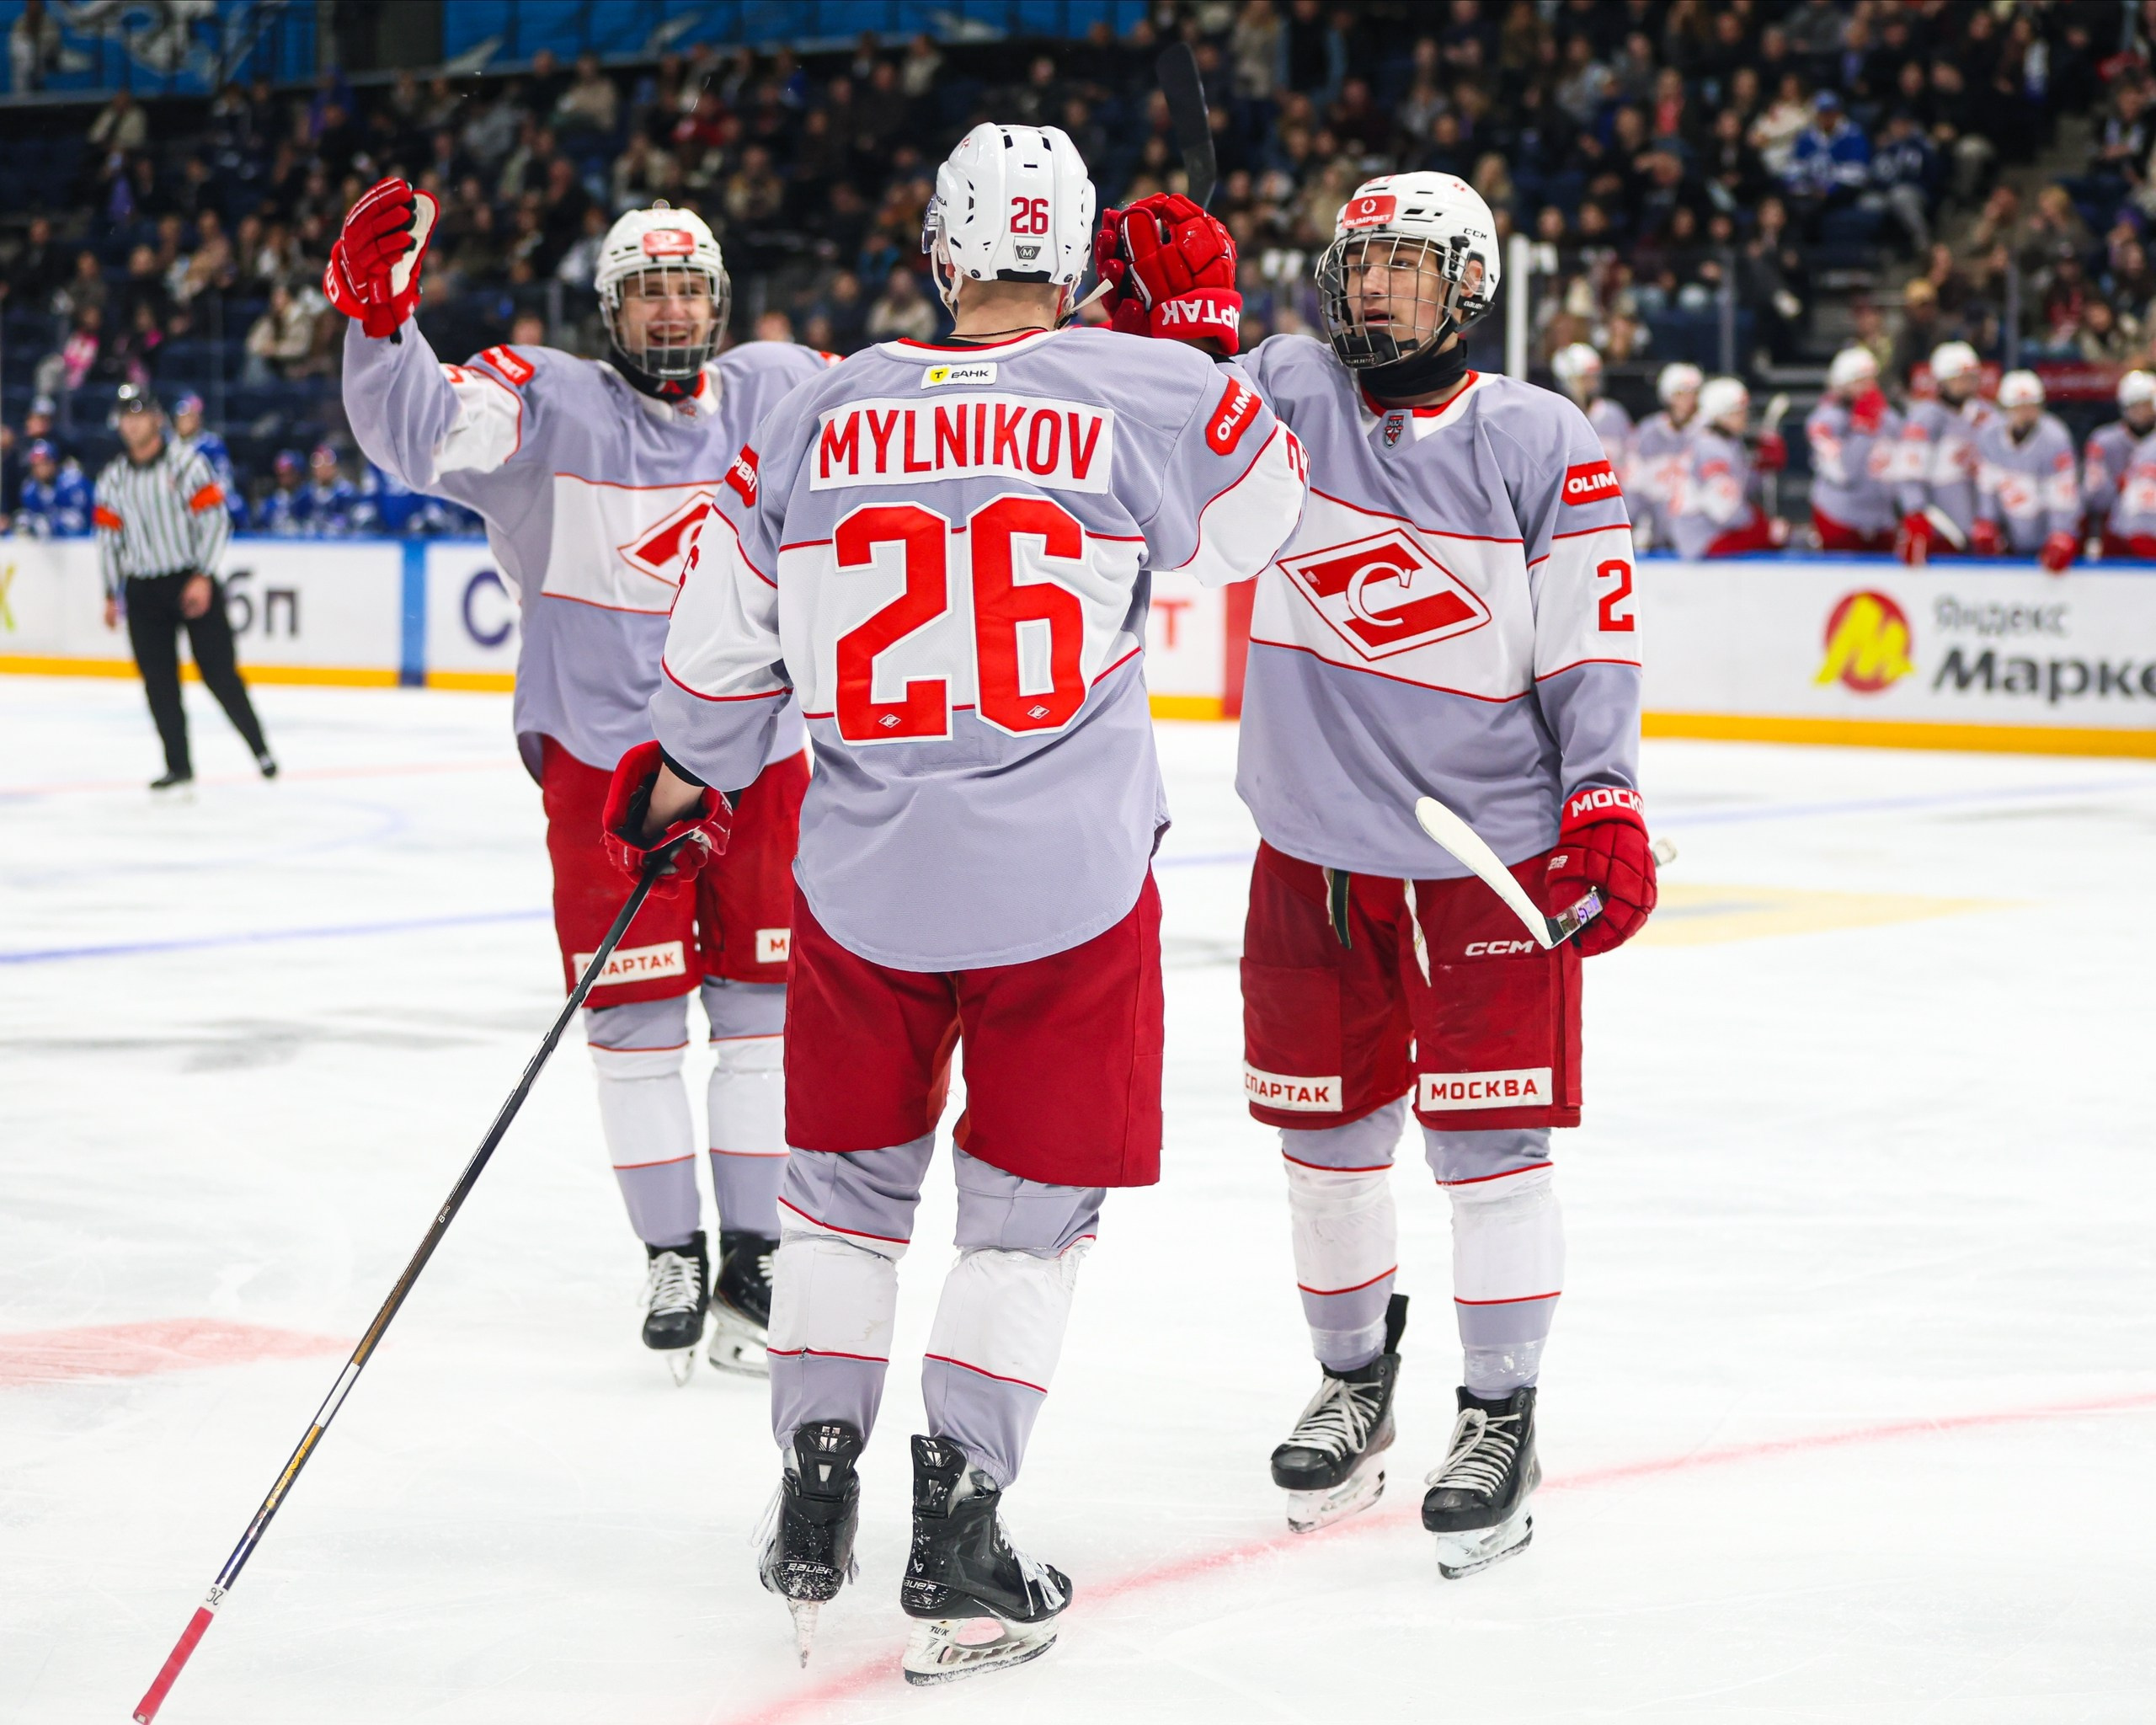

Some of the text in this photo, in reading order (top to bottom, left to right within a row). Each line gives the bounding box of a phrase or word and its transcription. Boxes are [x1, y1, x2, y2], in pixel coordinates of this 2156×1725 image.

[1011, 196, 1049, 235] 26
[1345, 214, 1391, 226] OLIMPBET
[1464, 227, 1487, 240] CCM
[951, 370, 990, 379] БАНК
[819, 403, 1102, 480] MYLNIKOV
[1568, 471, 1618, 494] OLIM
[224, 569, 298, 637] бп
[1597, 559, 1634, 632] 2
[834, 494, 1086, 744] 26
[1465, 940, 1534, 956] CCM
[1246, 1072, 1330, 1103] СПАРТАК
[1432, 1078, 1539, 1100] МОСКВА
[903, 1579, 937, 1592] AUER
